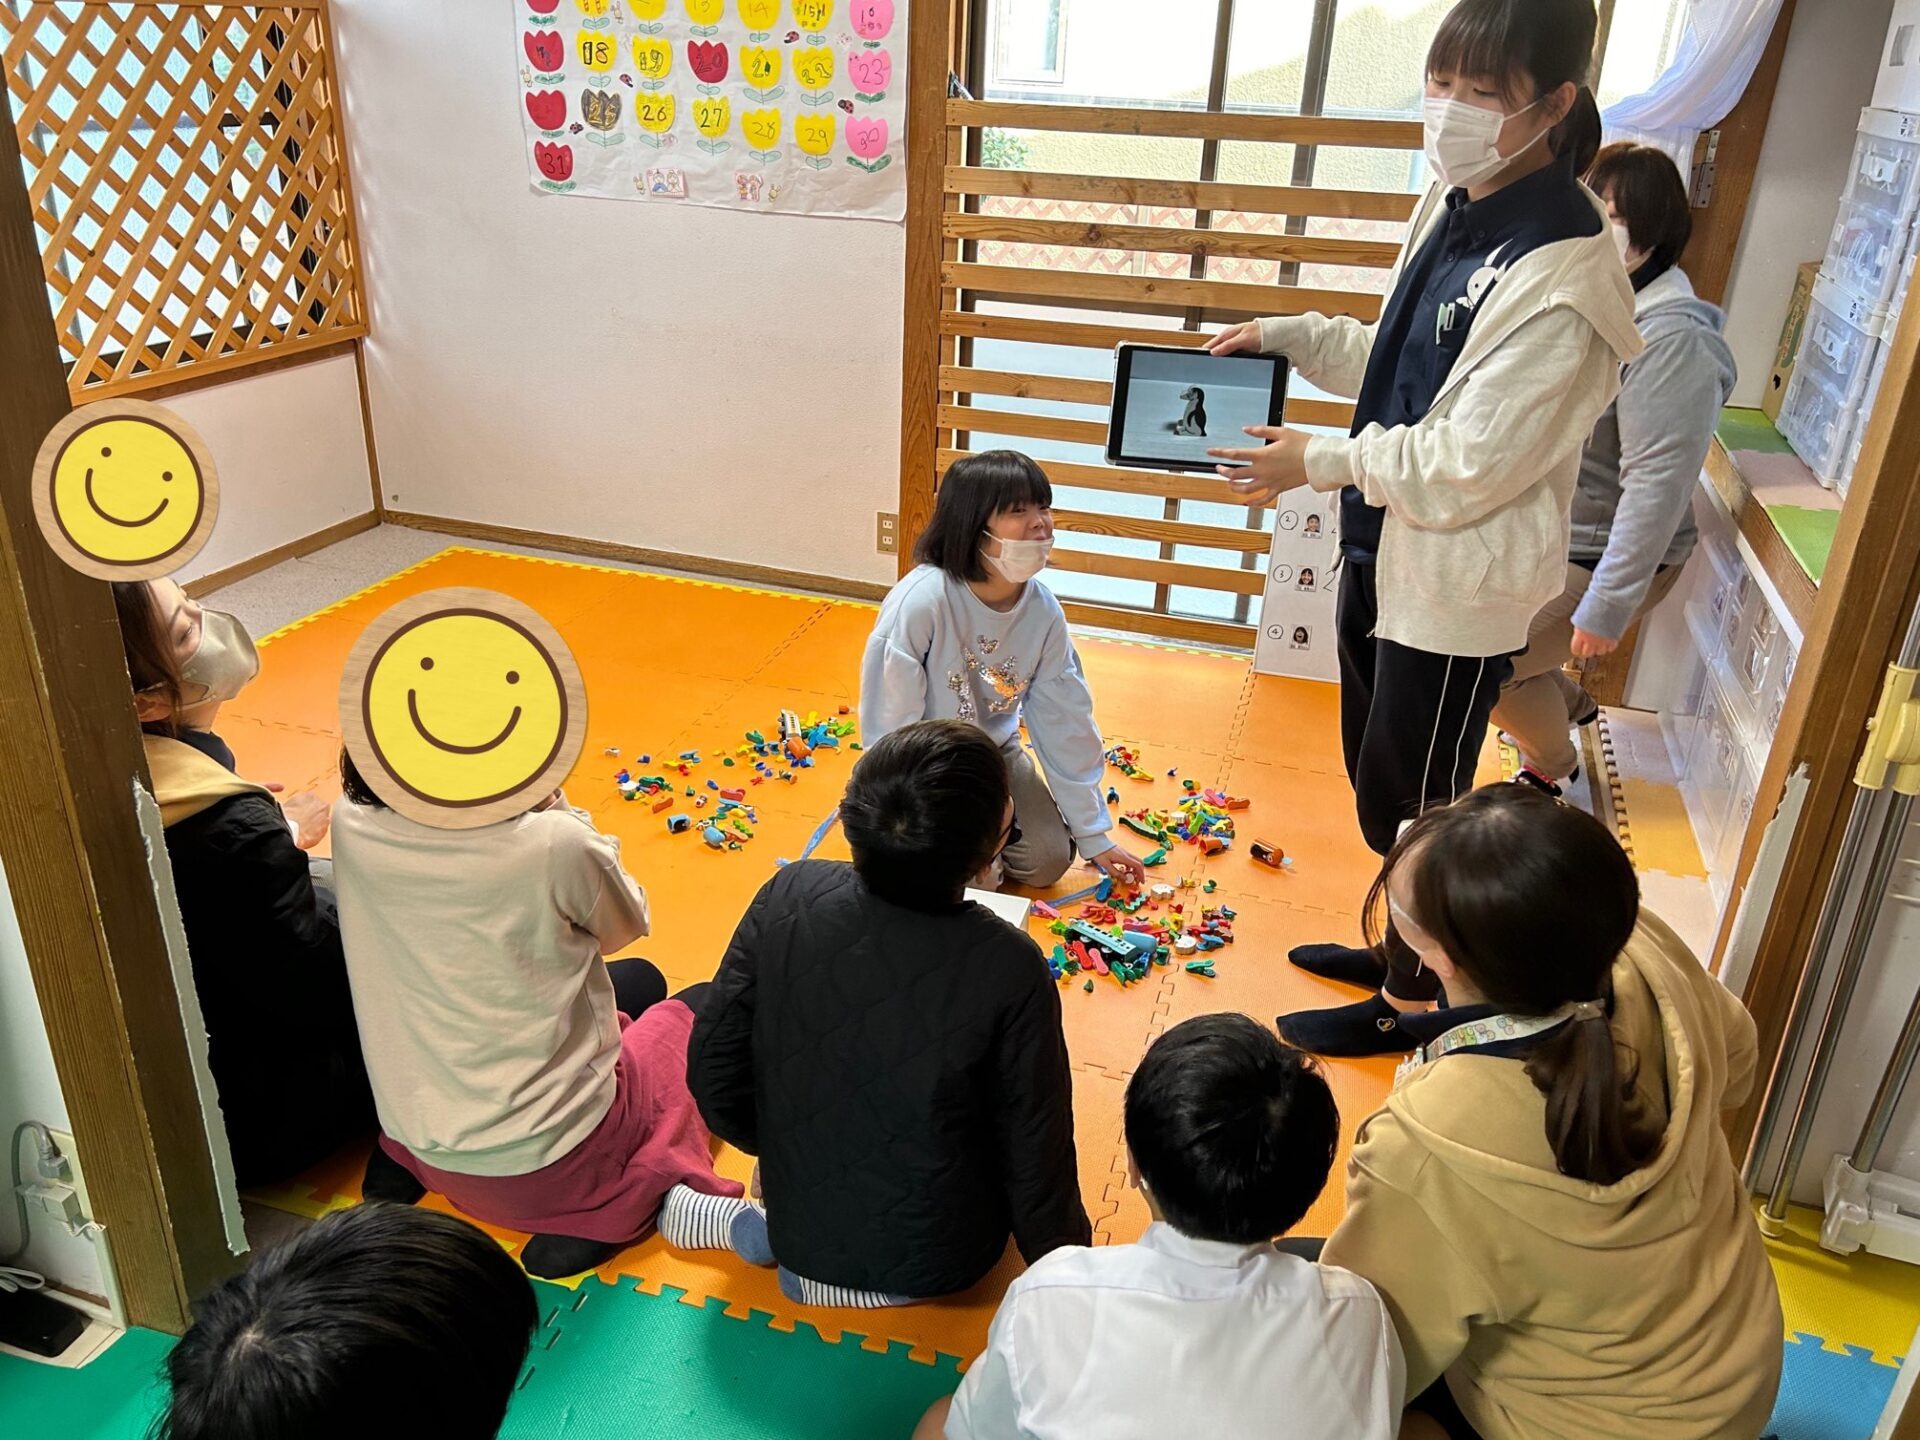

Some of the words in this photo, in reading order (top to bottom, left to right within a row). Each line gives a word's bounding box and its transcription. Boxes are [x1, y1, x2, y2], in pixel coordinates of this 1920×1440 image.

[583, 41, 609, 65] 18
[639, 49, 664, 72] 19
[802, 62, 832, 84] 22
[859, 58, 884, 85] 23
[643, 104, 667, 122] 26
[700, 108, 722, 128] 27
[752, 122, 776, 140] 28
[805, 128, 829, 147] 29
[544, 153, 566, 176] 31
